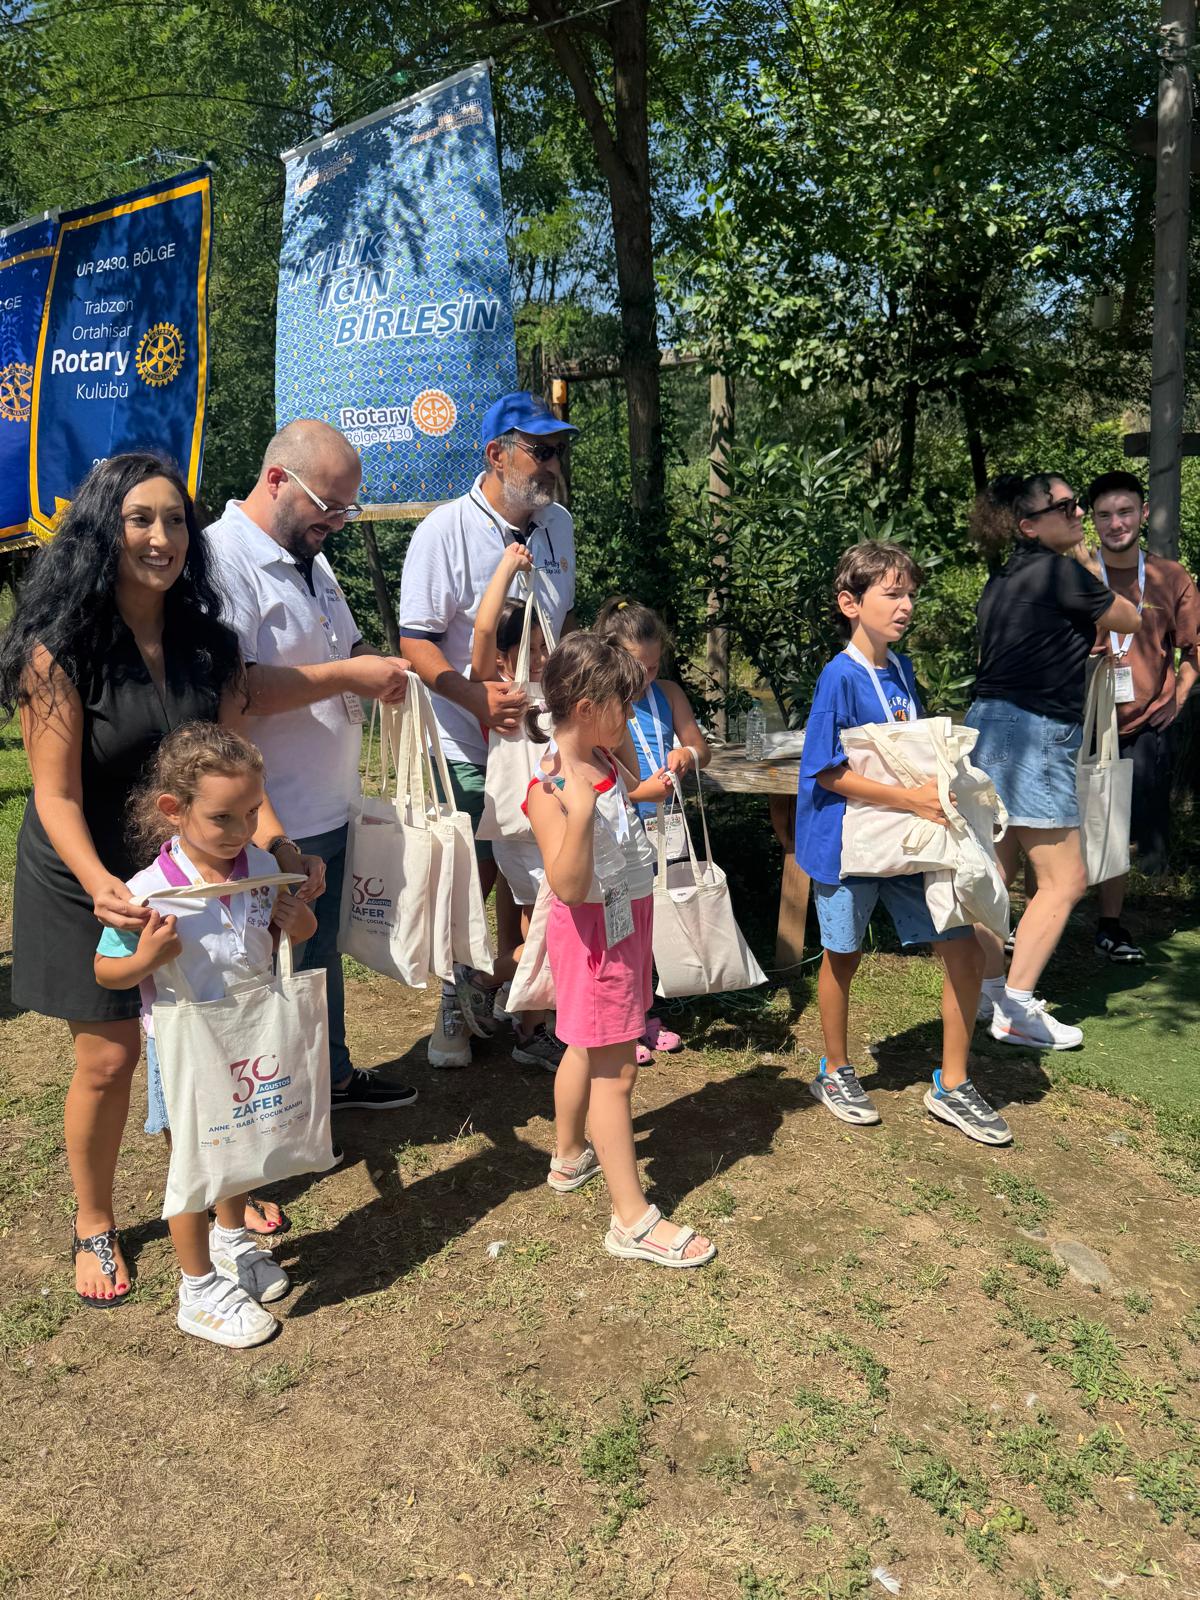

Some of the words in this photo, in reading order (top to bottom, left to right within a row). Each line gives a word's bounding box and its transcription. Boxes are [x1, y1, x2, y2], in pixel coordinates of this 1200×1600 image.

[77, 262, 94, 277] UR
[96, 256, 129, 273] 2430.
[133, 243, 176, 267] BÖLGE
[289, 231, 387, 290] İYİLİK
[319, 267, 394, 312] İÇİN
[84, 299, 134, 316] Trabzon
[72, 322, 133, 341] Ortahisar
[335, 294, 500, 347] BİRLEŞİN
[51, 348, 131, 376] Rotary
[76, 381, 129, 400] Kulübü
[342, 408, 408, 427] Rotary
[345, 431, 378, 445] Bölge
[381, 428, 412, 442] 2430
[230, 1054, 280, 1103] 30
[259, 1078, 290, 1093] AĞUSTOS
[232, 1094, 283, 1119] ZAFER
[208, 1124, 230, 1133] ANNE
[259, 1109, 283, 1121] ÇOCUK
